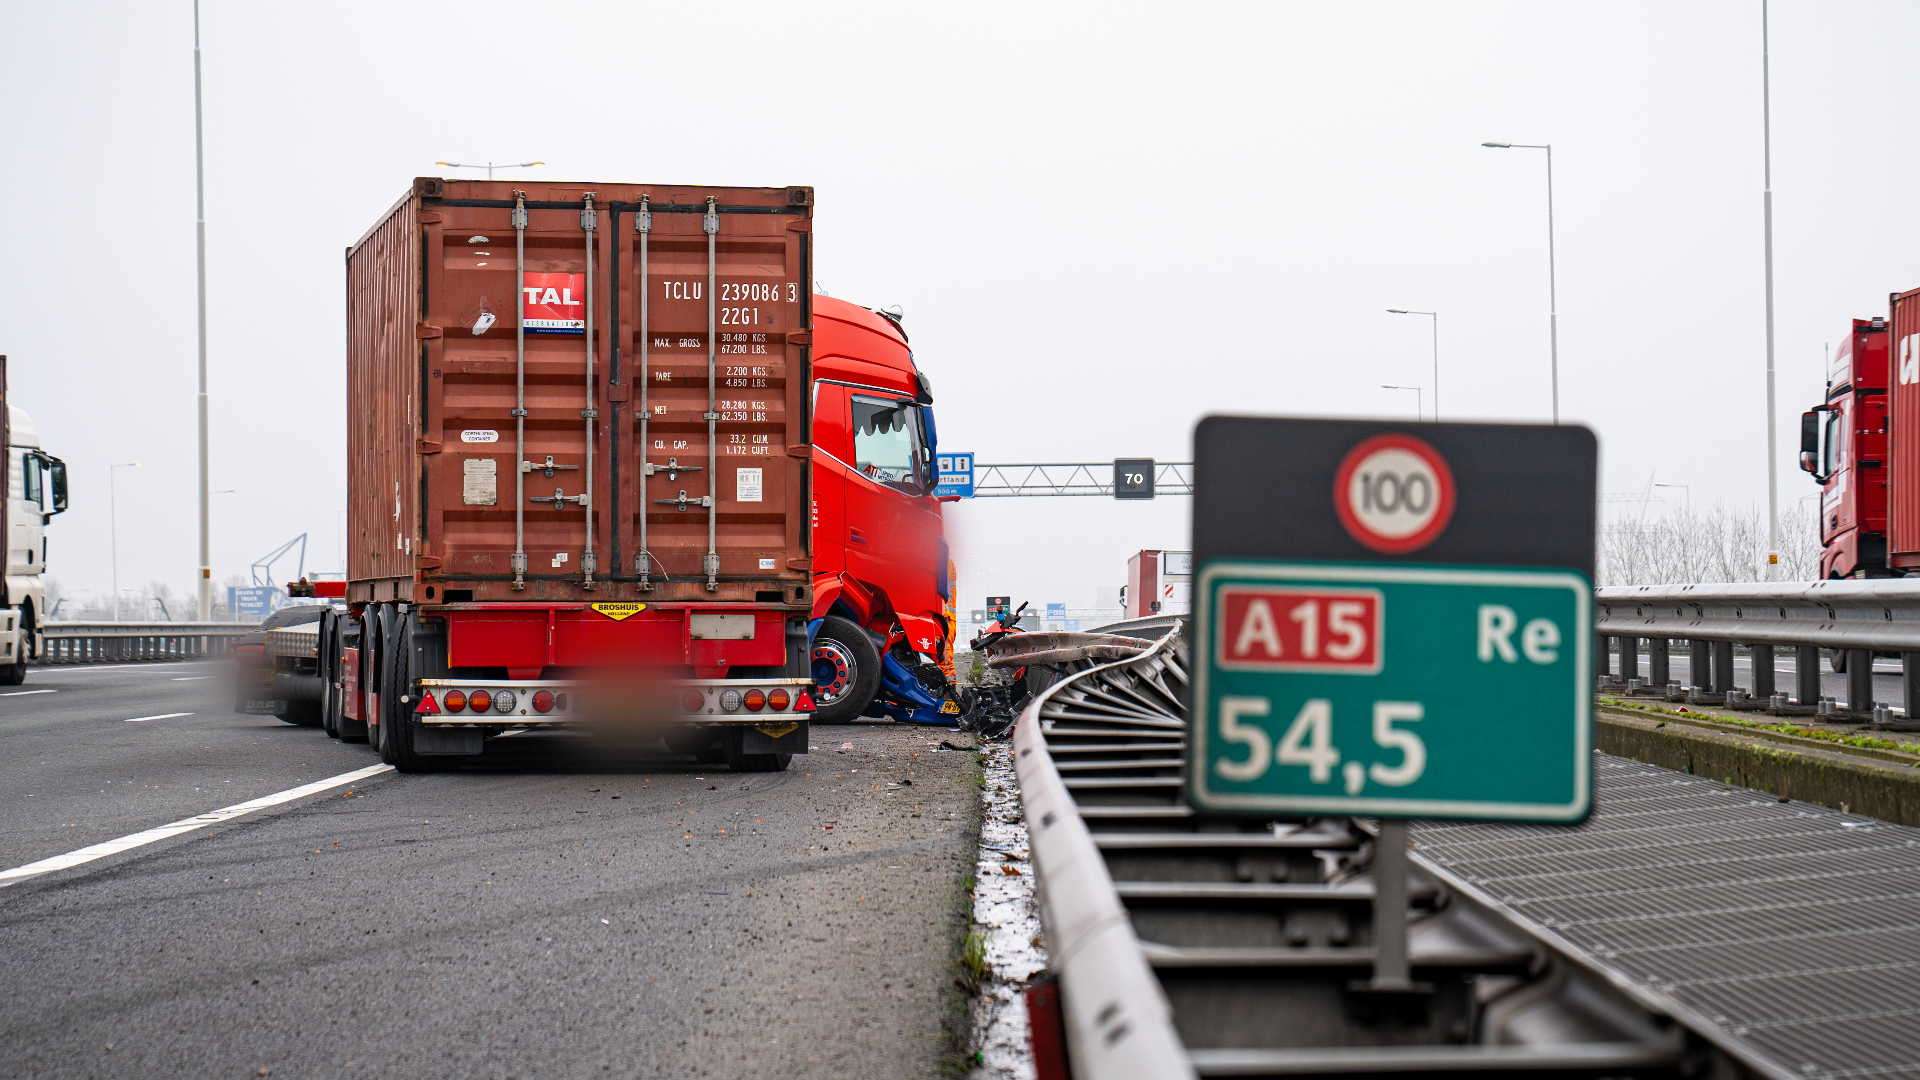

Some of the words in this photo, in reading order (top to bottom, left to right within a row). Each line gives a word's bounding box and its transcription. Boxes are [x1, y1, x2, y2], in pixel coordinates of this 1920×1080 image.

[523, 288, 580, 305] TAL
[664, 282, 702, 300] TCLU
[722, 284, 779, 302] 239086
[788, 284, 796, 302] 3
[722, 307, 758, 325] 22G1
[654, 338, 671, 347] MAX.
[679, 338, 700, 347] GROSS
[722, 334, 747, 342] 30.480
[752, 334, 768, 342] KGS.
[722, 345, 747, 354] 67.200
[752, 345, 768, 354] LBS.
[726, 367, 748, 376] 2.200
[752, 367, 768, 376] KGS.
[655, 372, 671, 381] TARE
[726, 379, 747, 387] 4.850
[752, 379, 768, 387] LBS.
[722, 401, 747, 409] 28.280
[752, 402, 768, 410] KGS.
[655, 406, 667, 415] NET
[722, 412, 747, 421] 62.350
[752, 412, 768, 421] LBS.
[730, 435, 746, 443] 33.2
[655, 440, 666, 449] CU.
[673, 440, 688, 449] CAP.
[726, 446, 746, 454] 1.172
[1124, 473, 1144, 484] 70
[1360, 472, 1433, 514] 100
[1234, 598, 1368, 660] A15
[1476, 604, 1562, 664] Re
[1214, 696, 1428, 795] 54,5
